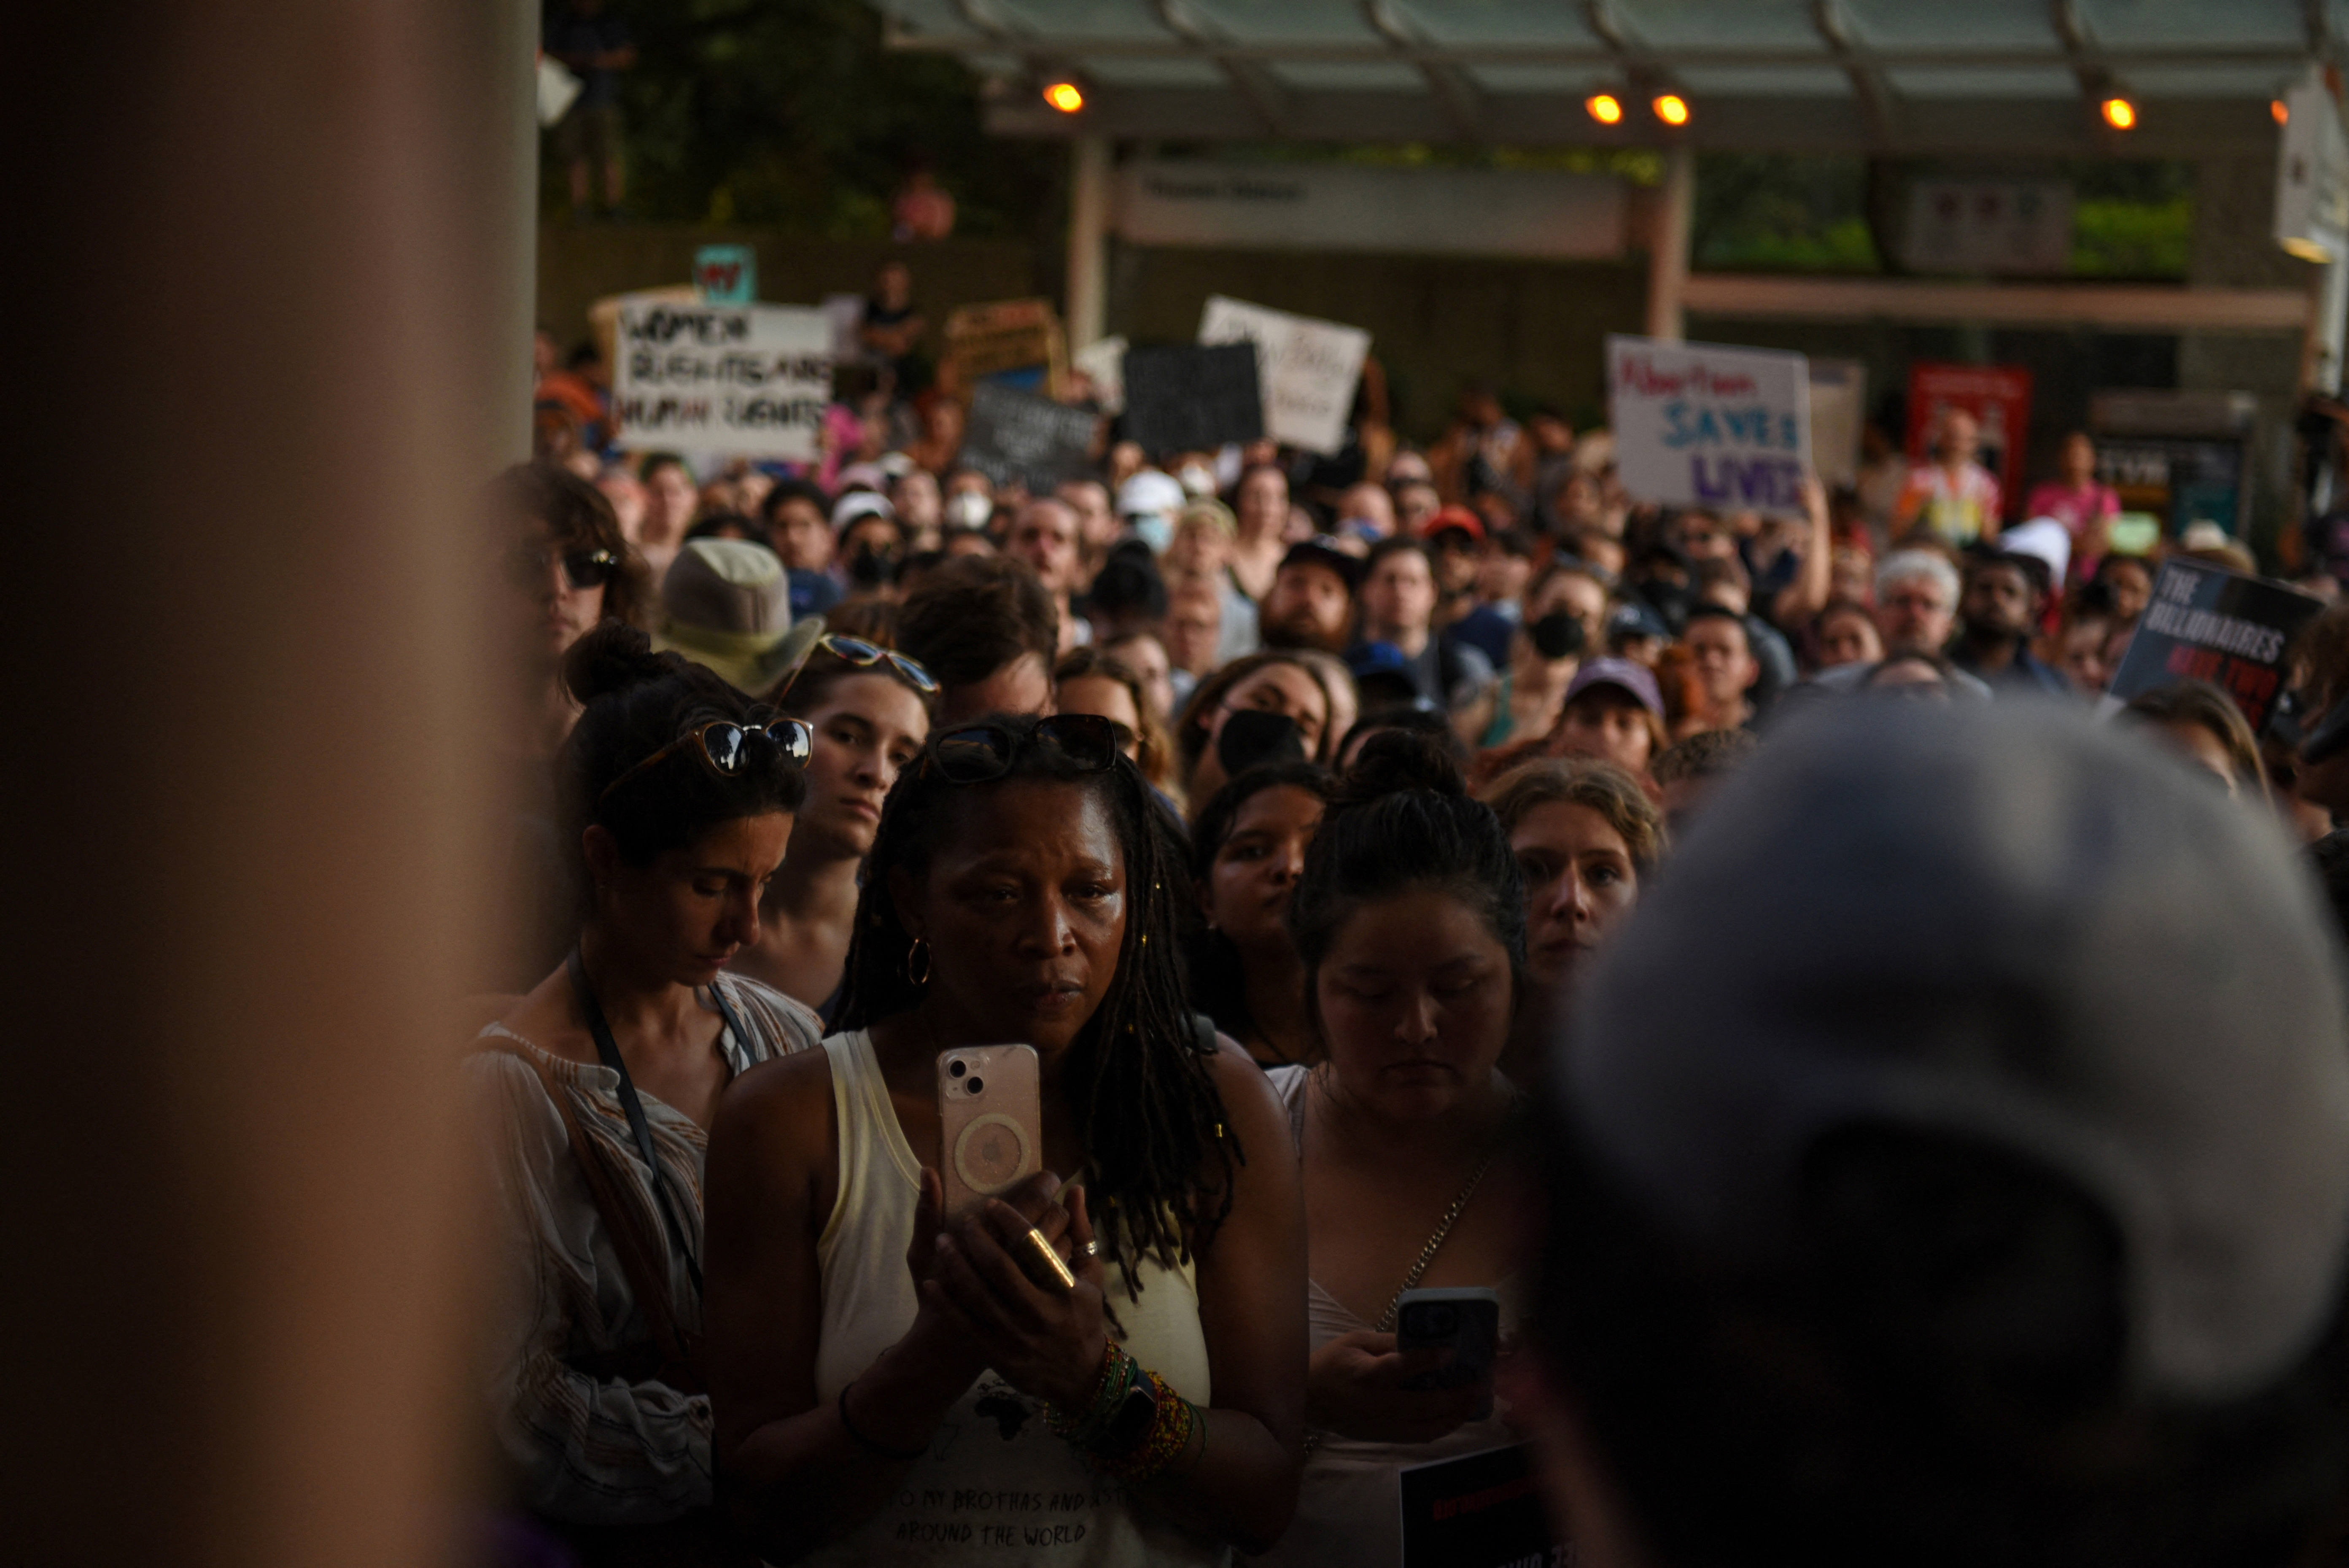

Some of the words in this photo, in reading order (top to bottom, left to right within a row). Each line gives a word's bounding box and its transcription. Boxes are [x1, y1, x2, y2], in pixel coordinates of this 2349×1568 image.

[621, 308, 749, 344] WOMEN
[1619, 357, 1759, 396] Abortion
[617, 397, 713, 428] HUMAN
[2160, 567, 2202, 605] THE
[2145, 601, 2287, 664] BILLIONAIRES
[923, 1489, 945, 1508] MY
[953, 1488, 1042, 1512] BROTHAS
[1049, 1492, 1085, 1512] AND
[896, 1520, 972, 1544] AROUND
[980, 1525, 1017, 1547] THE
[1024, 1524, 1086, 1547] WORLD
